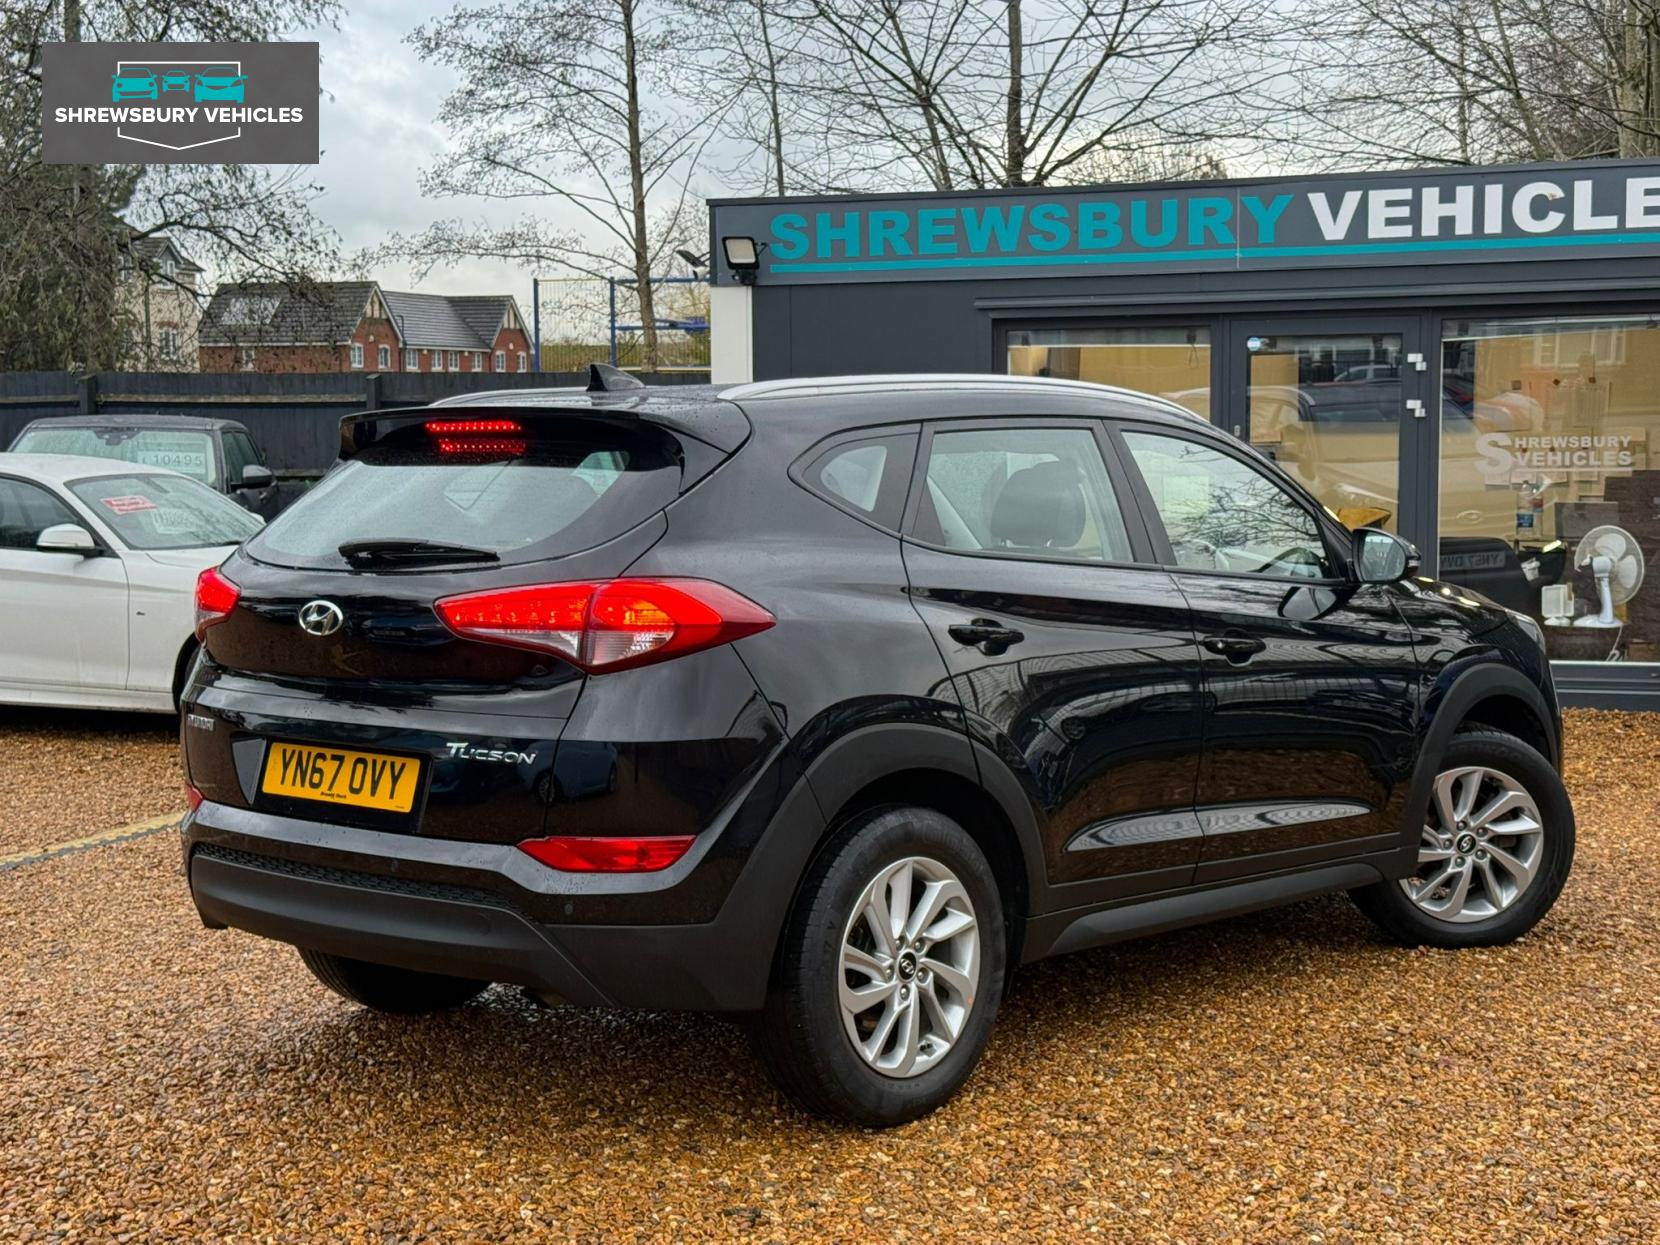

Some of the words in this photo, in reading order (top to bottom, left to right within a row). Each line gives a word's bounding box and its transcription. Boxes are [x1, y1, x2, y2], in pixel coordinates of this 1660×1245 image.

[769, 194, 1294, 260] SHREWSBURY
[1307, 176, 1660, 241] VEHICLE
[1515, 450, 1632, 466] VEHICLES
[280, 748, 345, 792] YN67
[348, 757, 406, 800] OVY
